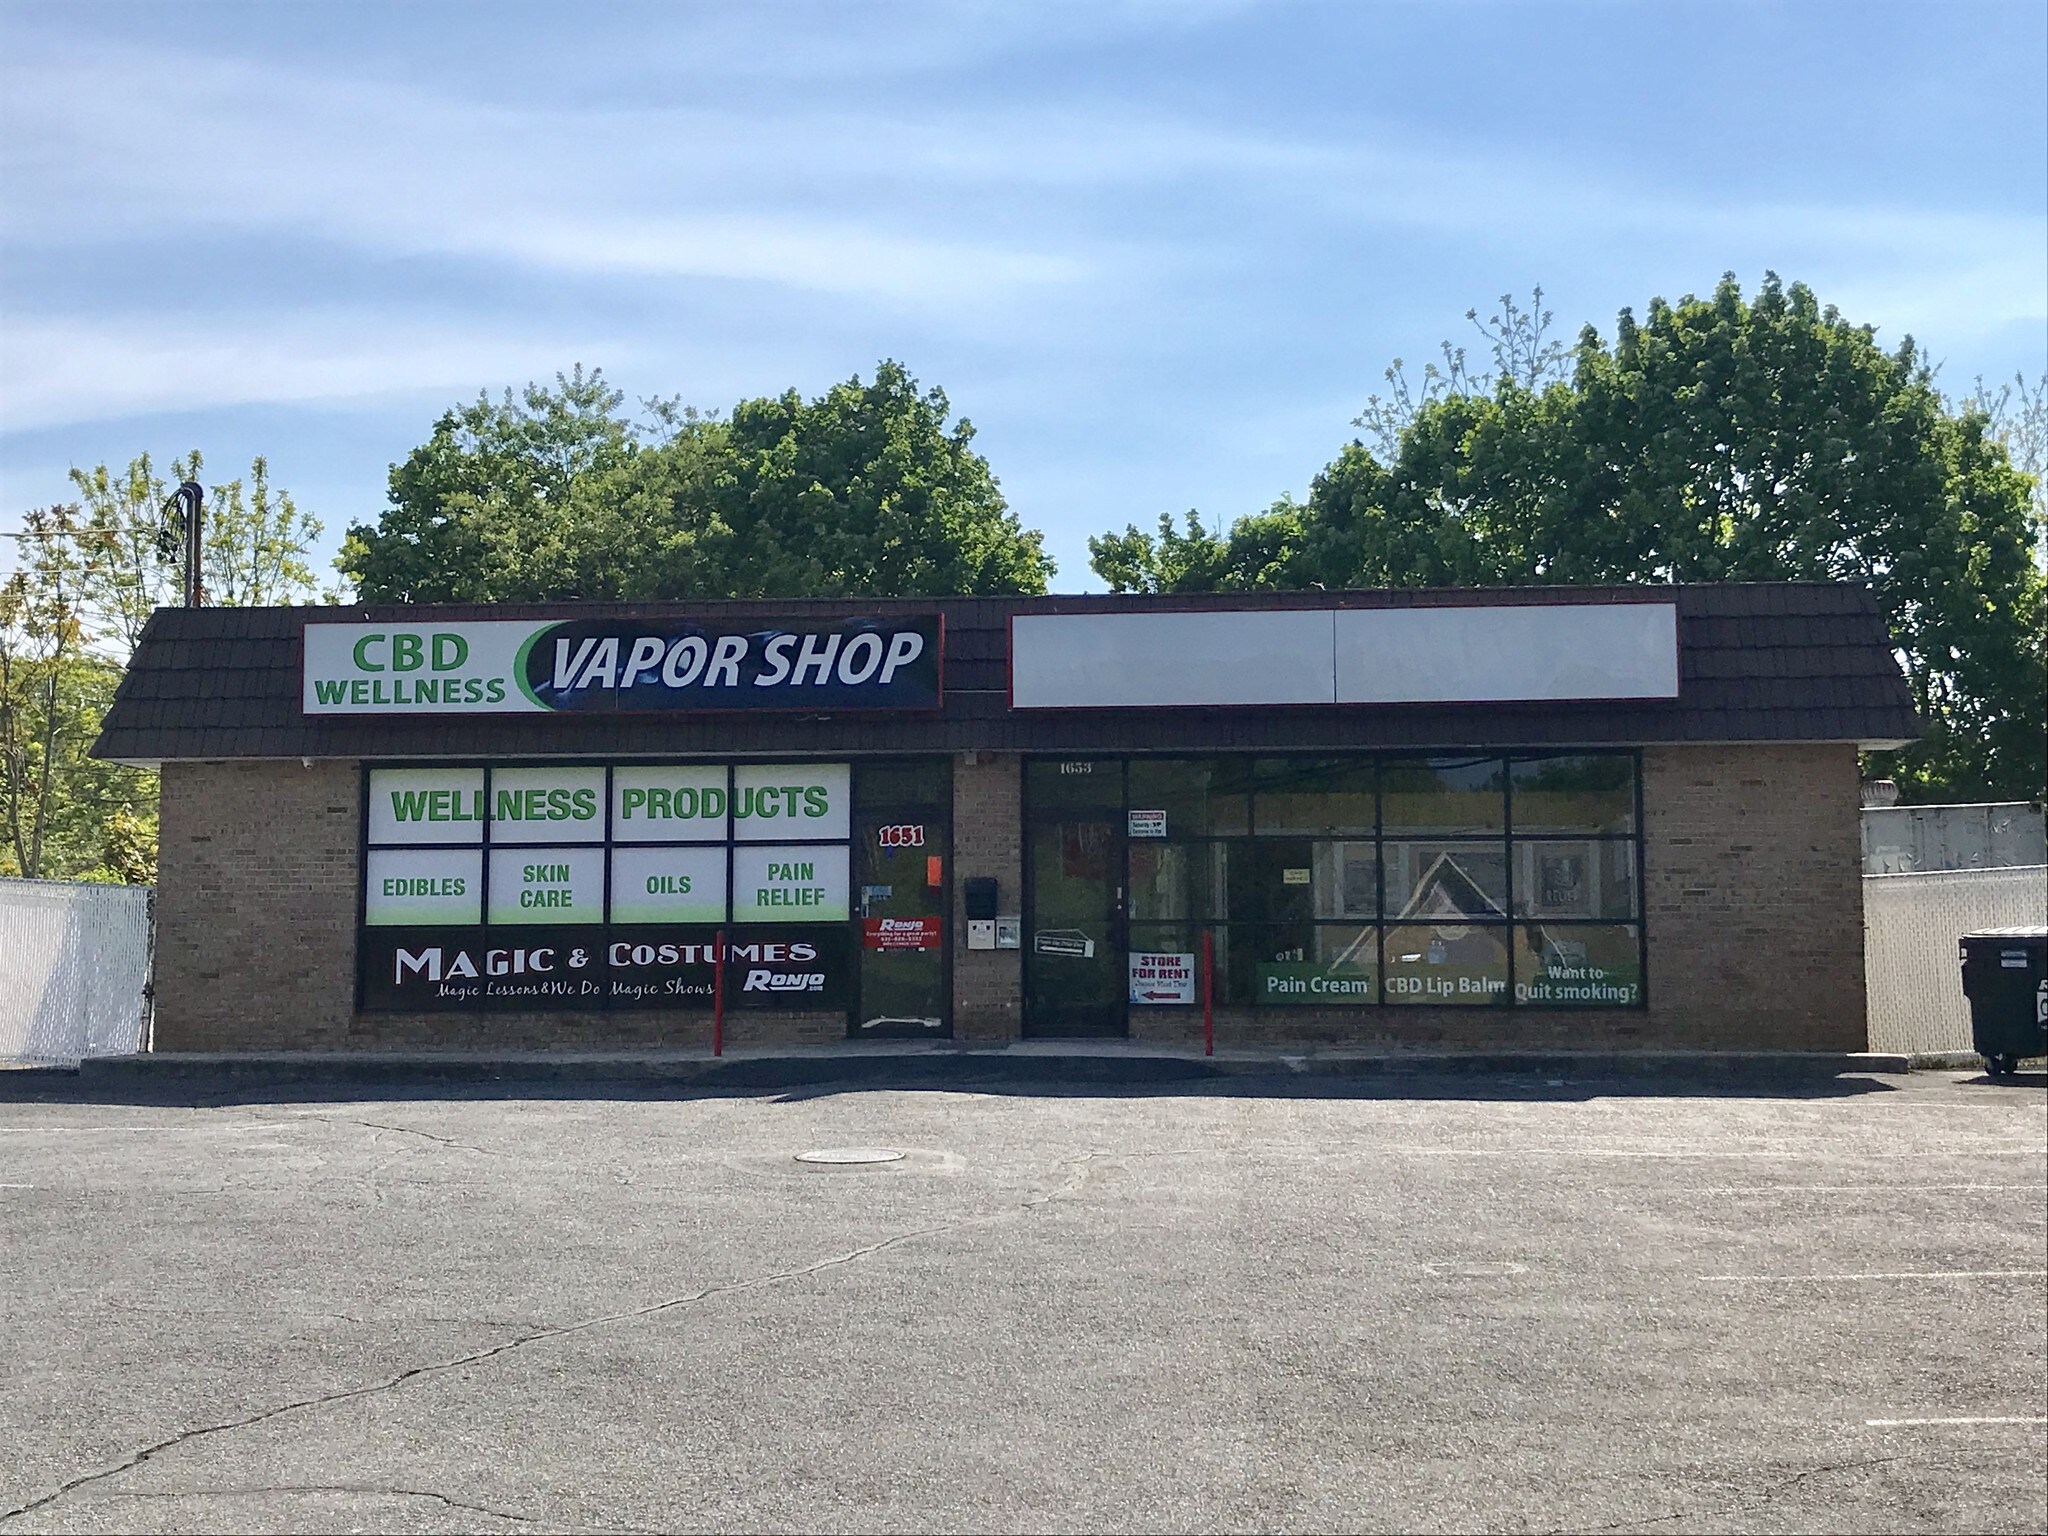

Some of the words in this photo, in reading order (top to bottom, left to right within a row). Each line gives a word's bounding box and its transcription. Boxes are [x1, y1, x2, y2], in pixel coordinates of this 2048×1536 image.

[353, 633, 469, 672] CBD
[552, 635, 757, 689] VAPOR
[754, 632, 924, 686] SHOP
[315, 678, 506, 705] WELLNESS
[1061, 763, 1092, 774] 1653
[391, 788, 597, 822] WELLNESS
[622, 786, 829, 819] PRODUCTS
[879, 825, 925, 847] 1651
[523, 864, 570, 883] SKIN
[767, 863, 814, 881] PAIN
[383, 878, 466, 897] EDIBLES
[646, 876, 691, 894] OILS
[520, 890, 573, 908] CARE
[757, 888, 825, 906] RELIEF
[395, 947, 555, 985] MAGIC
[568, 949, 589, 968] &
[1141, 956, 1181, 966] STORE
[1132, 968, 1155, 978] FOR
[1159, 969, 1190, 979] RENT
[1548, 966, 1585, 979] Want
[1588, 966, 1604, 979] to
[436, 983, 480, 1001] Magic
[581, 980, 600, 995] Do
[609, 981, 658, 1000] Magic
[664, 977, 715, 995] Shows
[1267, 976, 1306, 993] Pain
[1310, 976, 1368, 994] Cream
[1385, 977, 1422, 993] CBD
[1426, 976, 1454, 997] Lip
[1459, 976, 1506, 993] Balm
[1515, 982, 1551, 1000] Quit
[1555, 982, 1638, 1003] smoking?
